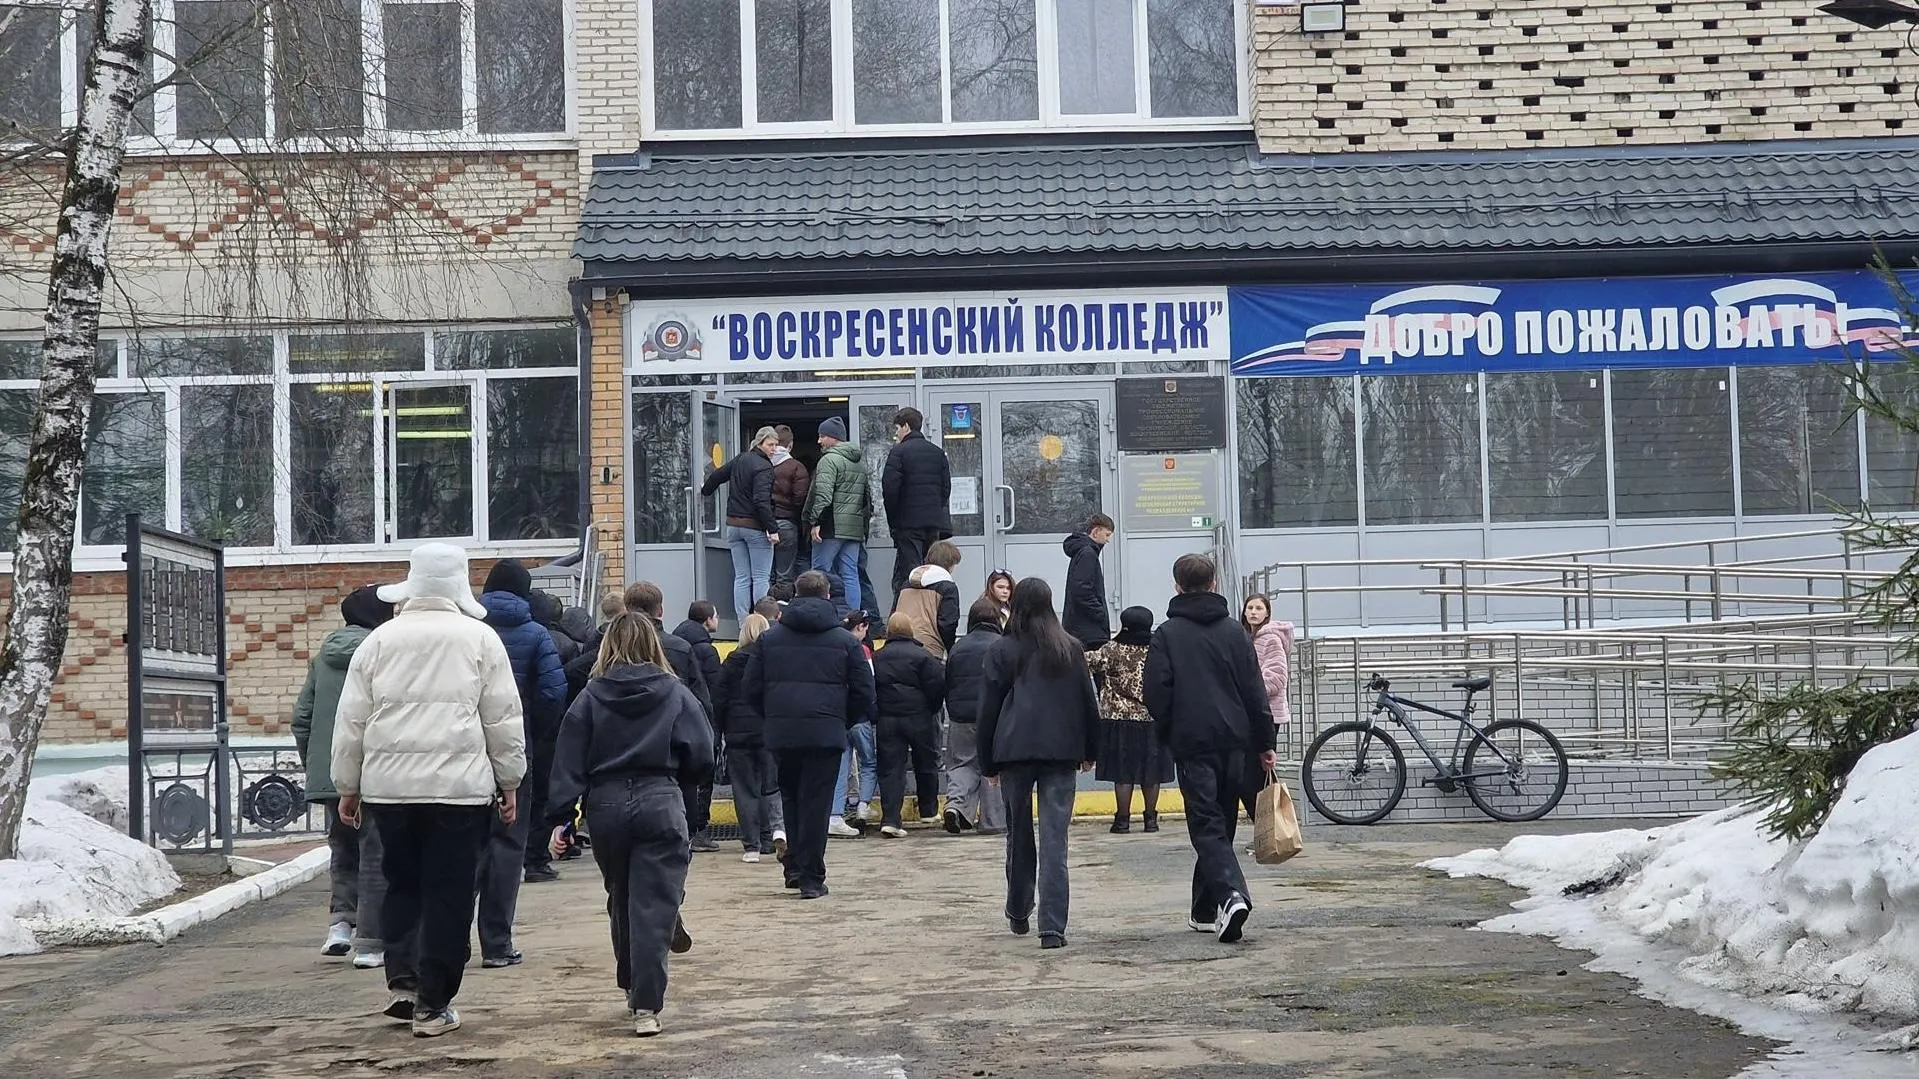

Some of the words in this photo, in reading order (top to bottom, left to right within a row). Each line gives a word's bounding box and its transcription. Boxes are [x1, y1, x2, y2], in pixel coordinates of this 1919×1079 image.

[712, 297, 1024, 361] “ВОСКРЕСЕНСКИЙ
[1034, 301, 1223, 354] КОЛЛЕДЖ”
[1360, 311, 1503, 364] ДОБРО
[1515, 302, 1848, 354] ПОЖАЛОВАТЬ!
